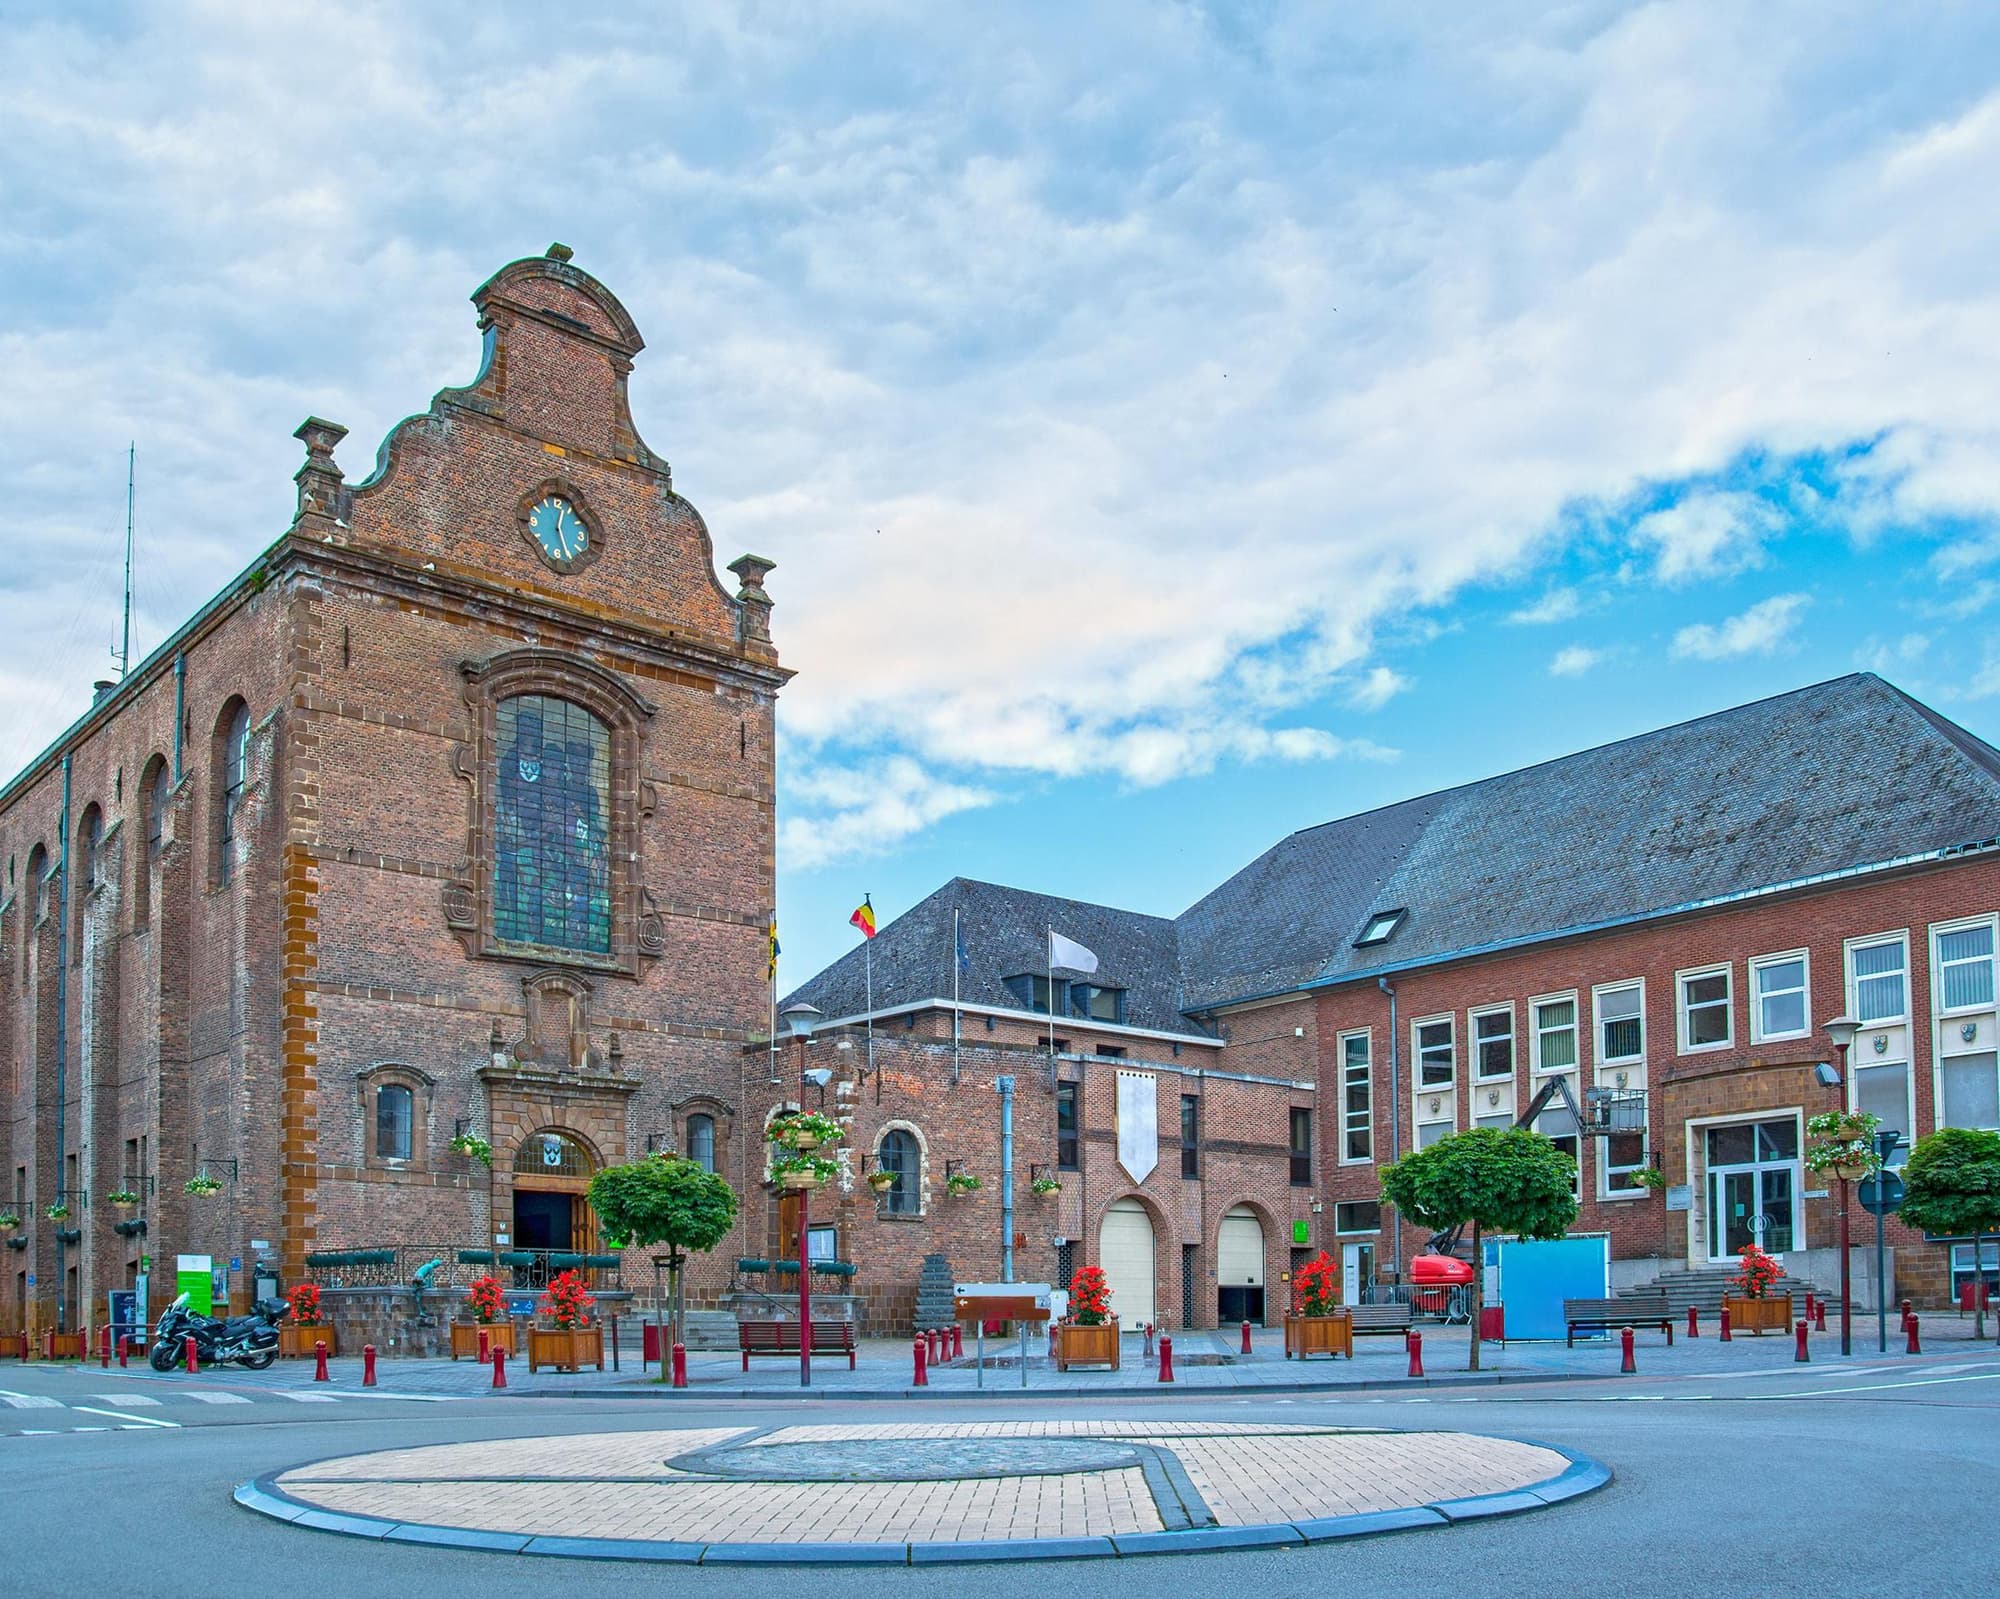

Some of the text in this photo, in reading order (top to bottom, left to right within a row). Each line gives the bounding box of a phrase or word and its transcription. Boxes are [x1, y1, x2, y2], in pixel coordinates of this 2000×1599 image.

[553, 498, 562, 509] 12
[530, 516, 538, 527] 9
[577, 531, 585, 541] 3
[553, 548, 561, 558] 6
